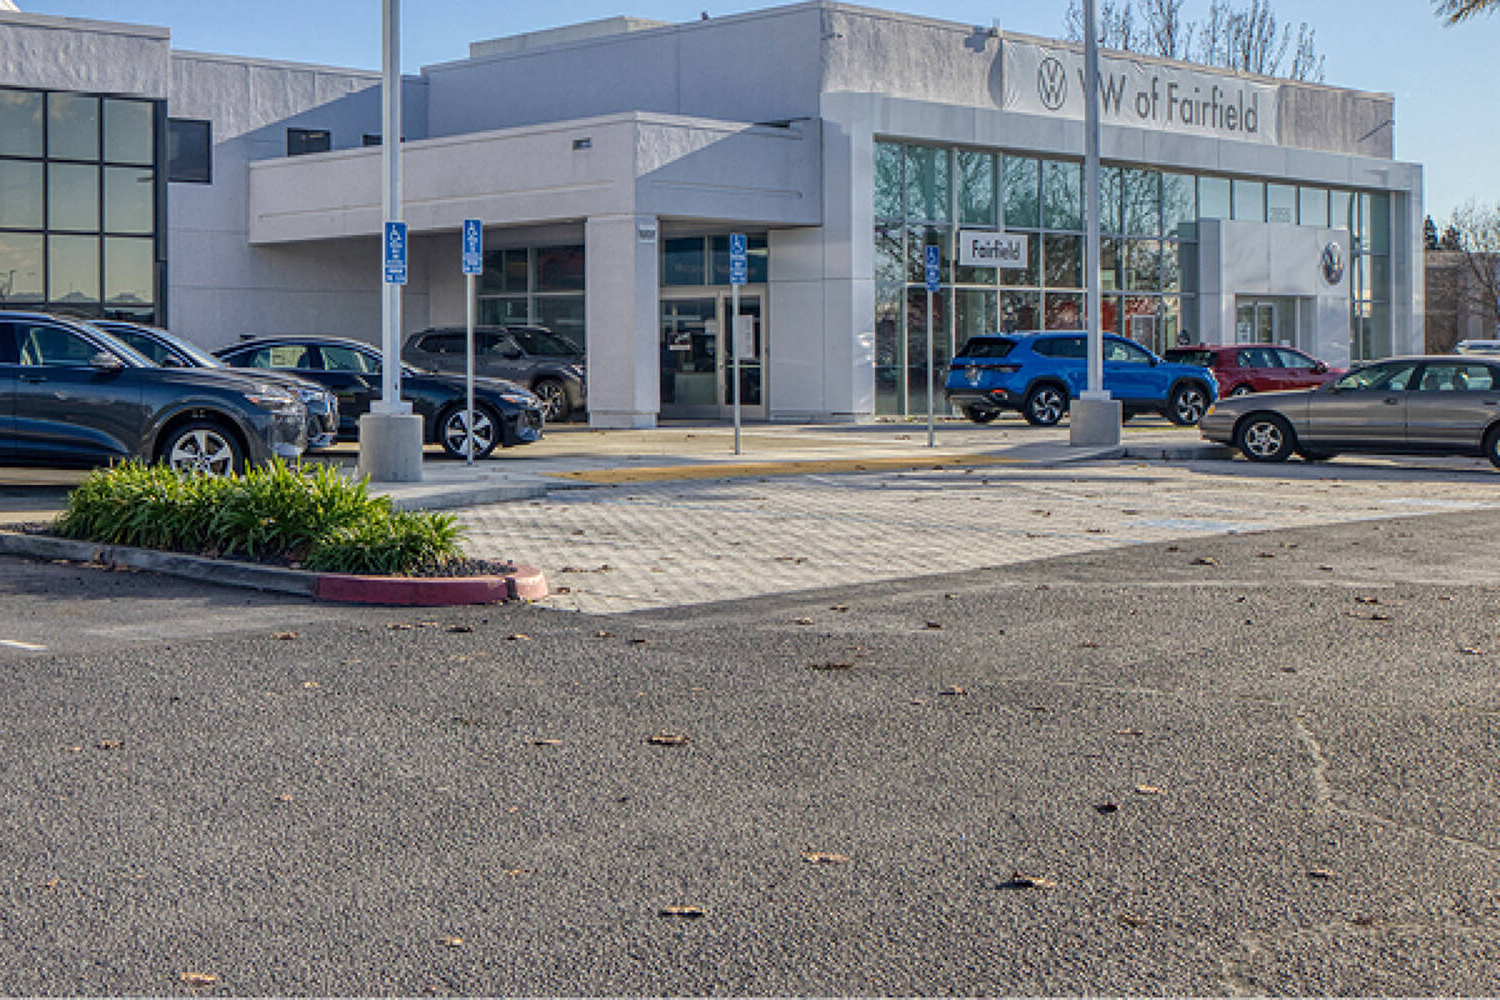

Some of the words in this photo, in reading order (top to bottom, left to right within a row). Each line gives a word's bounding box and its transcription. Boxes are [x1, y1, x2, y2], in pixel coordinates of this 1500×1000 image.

[1134, 75, 1159, 121] of
[1166, 81, 1259, 134] Fairfield
[972, 239, 1021, 261] Fairfield
